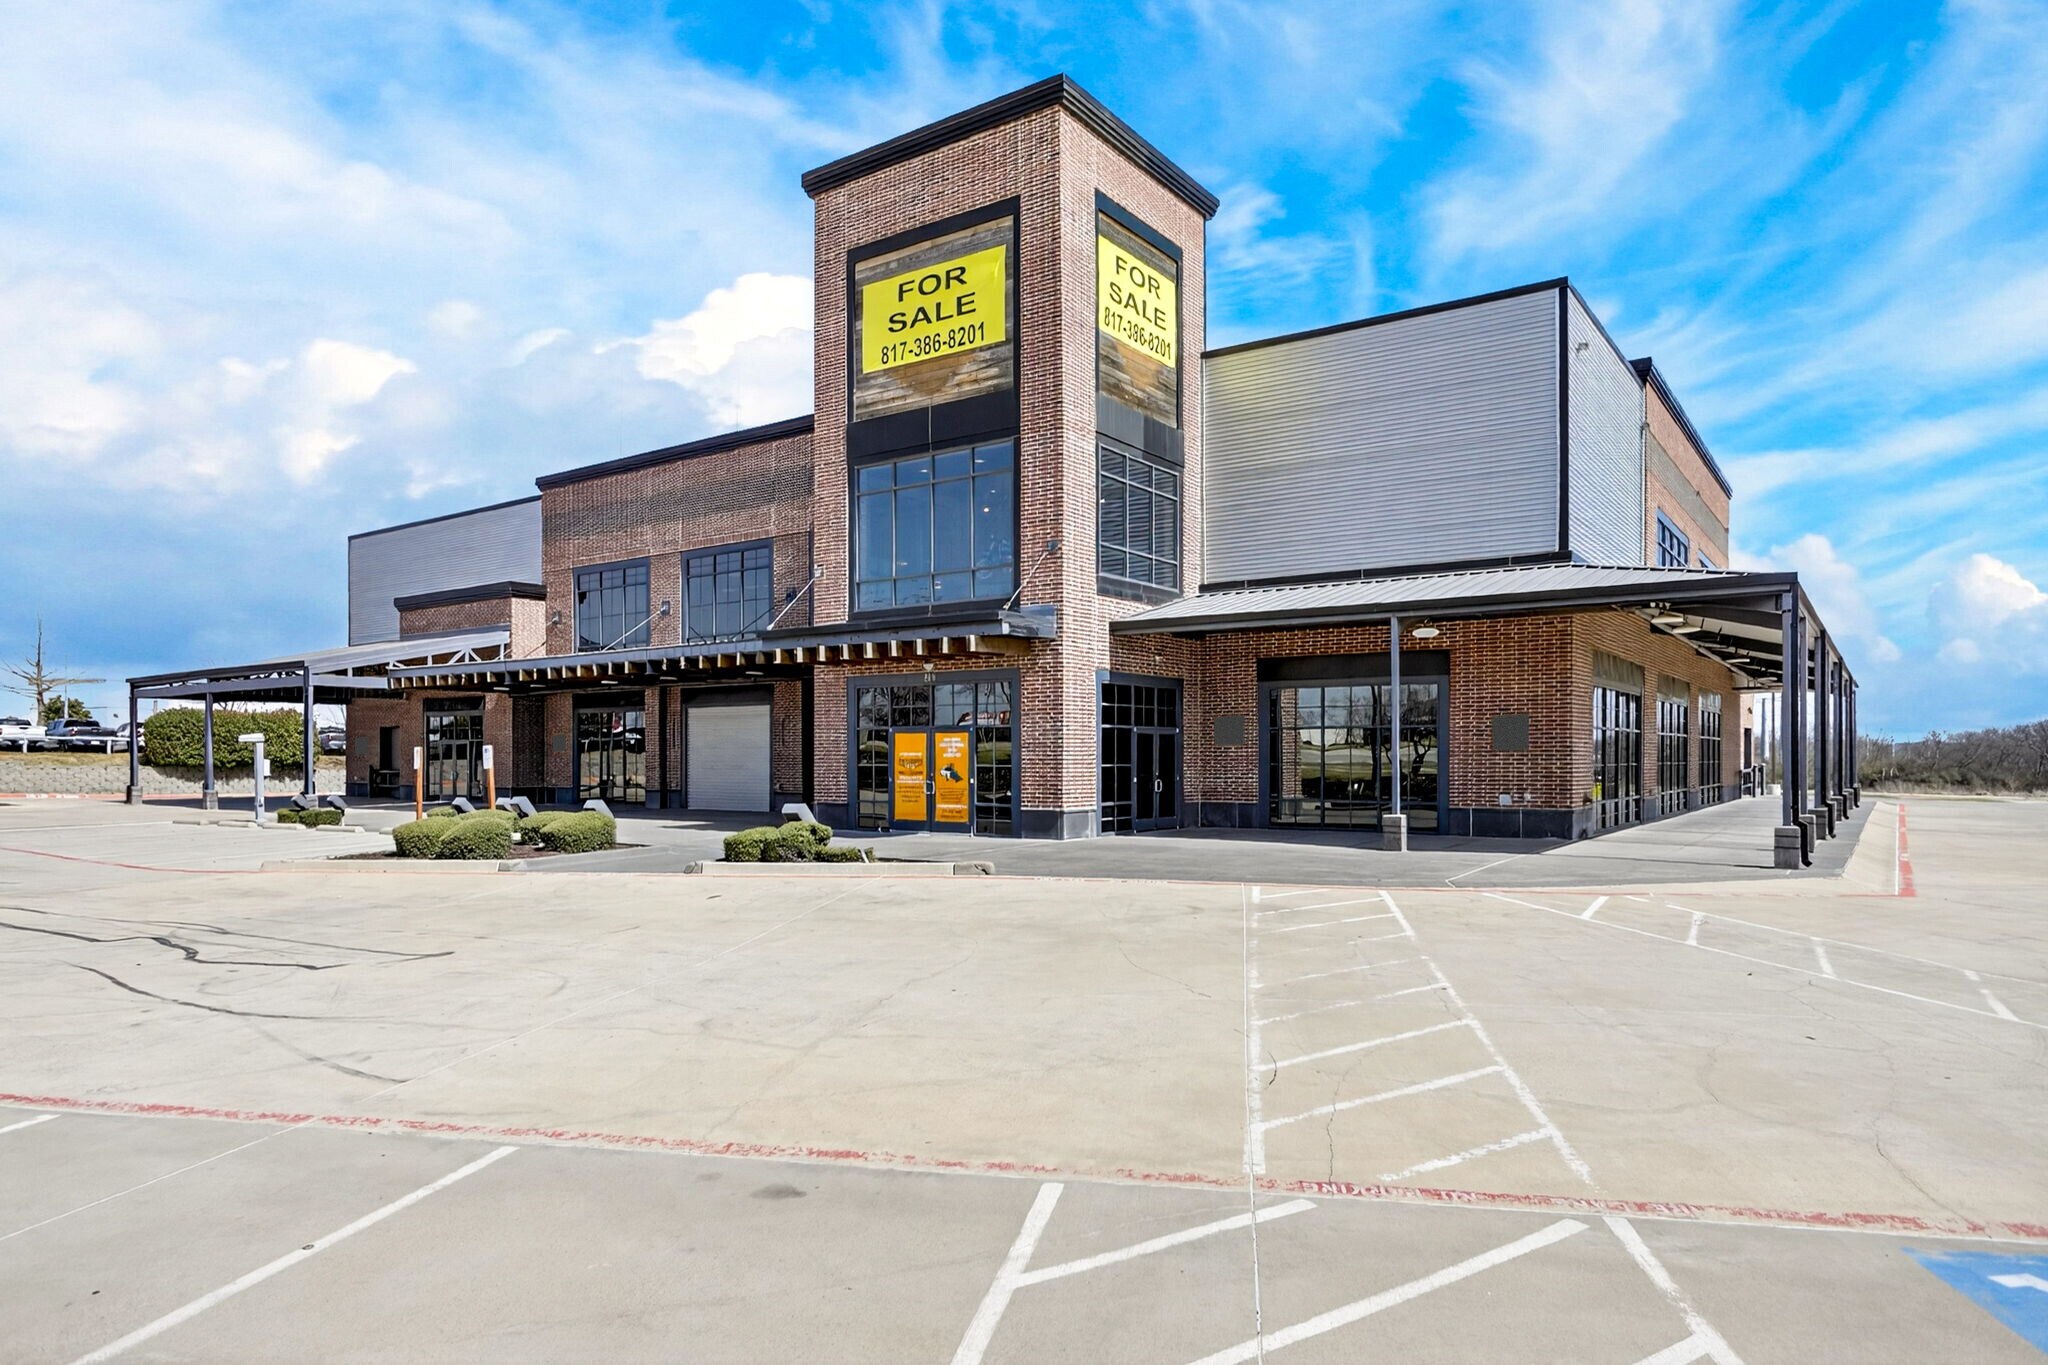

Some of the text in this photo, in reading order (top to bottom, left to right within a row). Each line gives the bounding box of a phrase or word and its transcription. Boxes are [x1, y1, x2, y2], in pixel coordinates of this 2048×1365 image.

[898, 267, 967, 302] FOR
[1116, 256, 1160, 300] FOR
[888, 292, 976, 333] SALE
[1110, 282, 1166, 331] SALE
[882, 321, 985, 365] 817-386-8201
[1105, 306, 1171, 360] 817-386-8201
